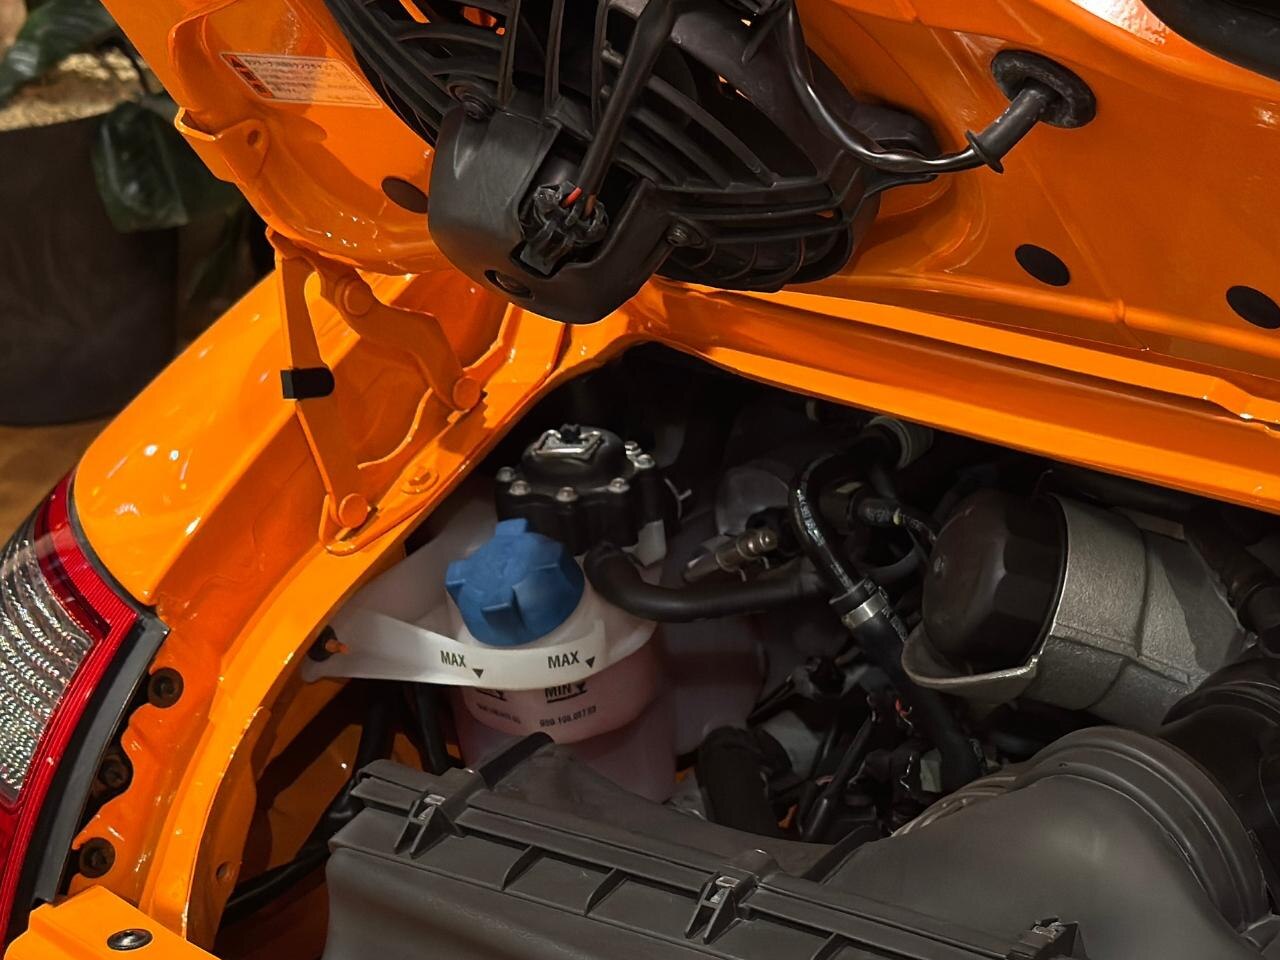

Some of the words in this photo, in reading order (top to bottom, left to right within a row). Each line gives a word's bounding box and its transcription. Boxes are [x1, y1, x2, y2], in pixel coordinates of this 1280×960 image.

[440, 650, 467, 668] MAX
[547, 651, 580, 669] MAX
[544, 683, 573, 699] MIN
